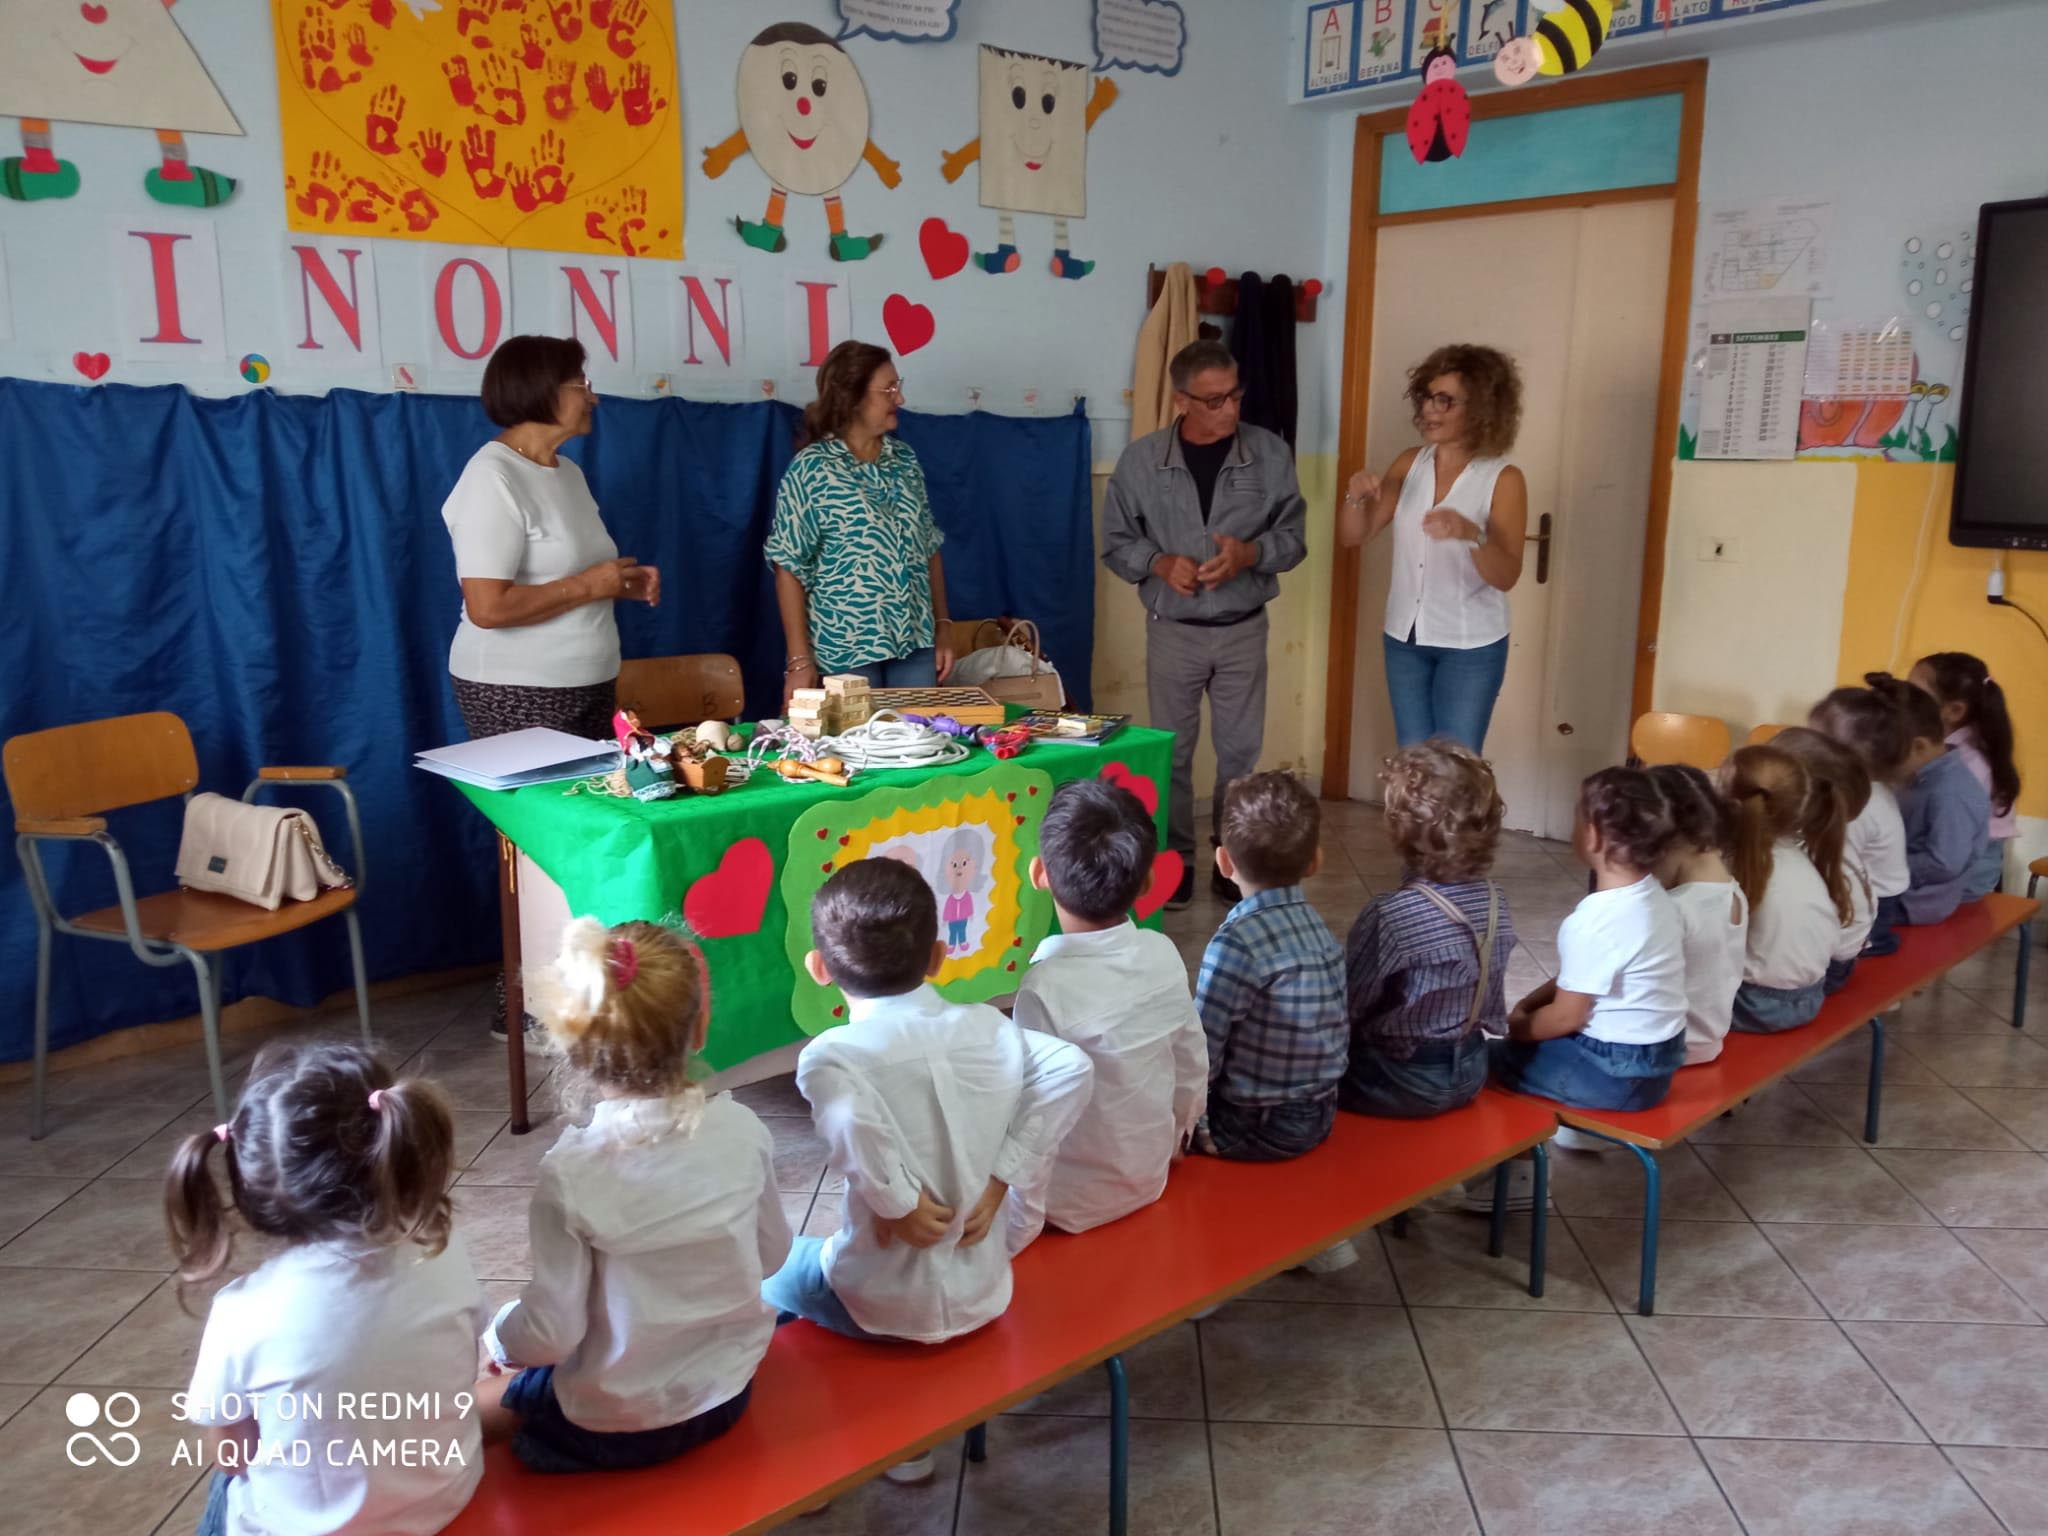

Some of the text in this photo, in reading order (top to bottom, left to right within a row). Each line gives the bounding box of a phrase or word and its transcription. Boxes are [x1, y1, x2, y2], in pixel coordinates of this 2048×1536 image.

[1323, 8, 1339, 35] A
[1375, 0, 1393, 25] B
[1656, 2, 1708, 21] GLATO
[1310, 71, 1348, 88] ALTALENA
[1359, 61, 1400, 79] BEFANA
[128, 230, 837, 367] I NONNI
